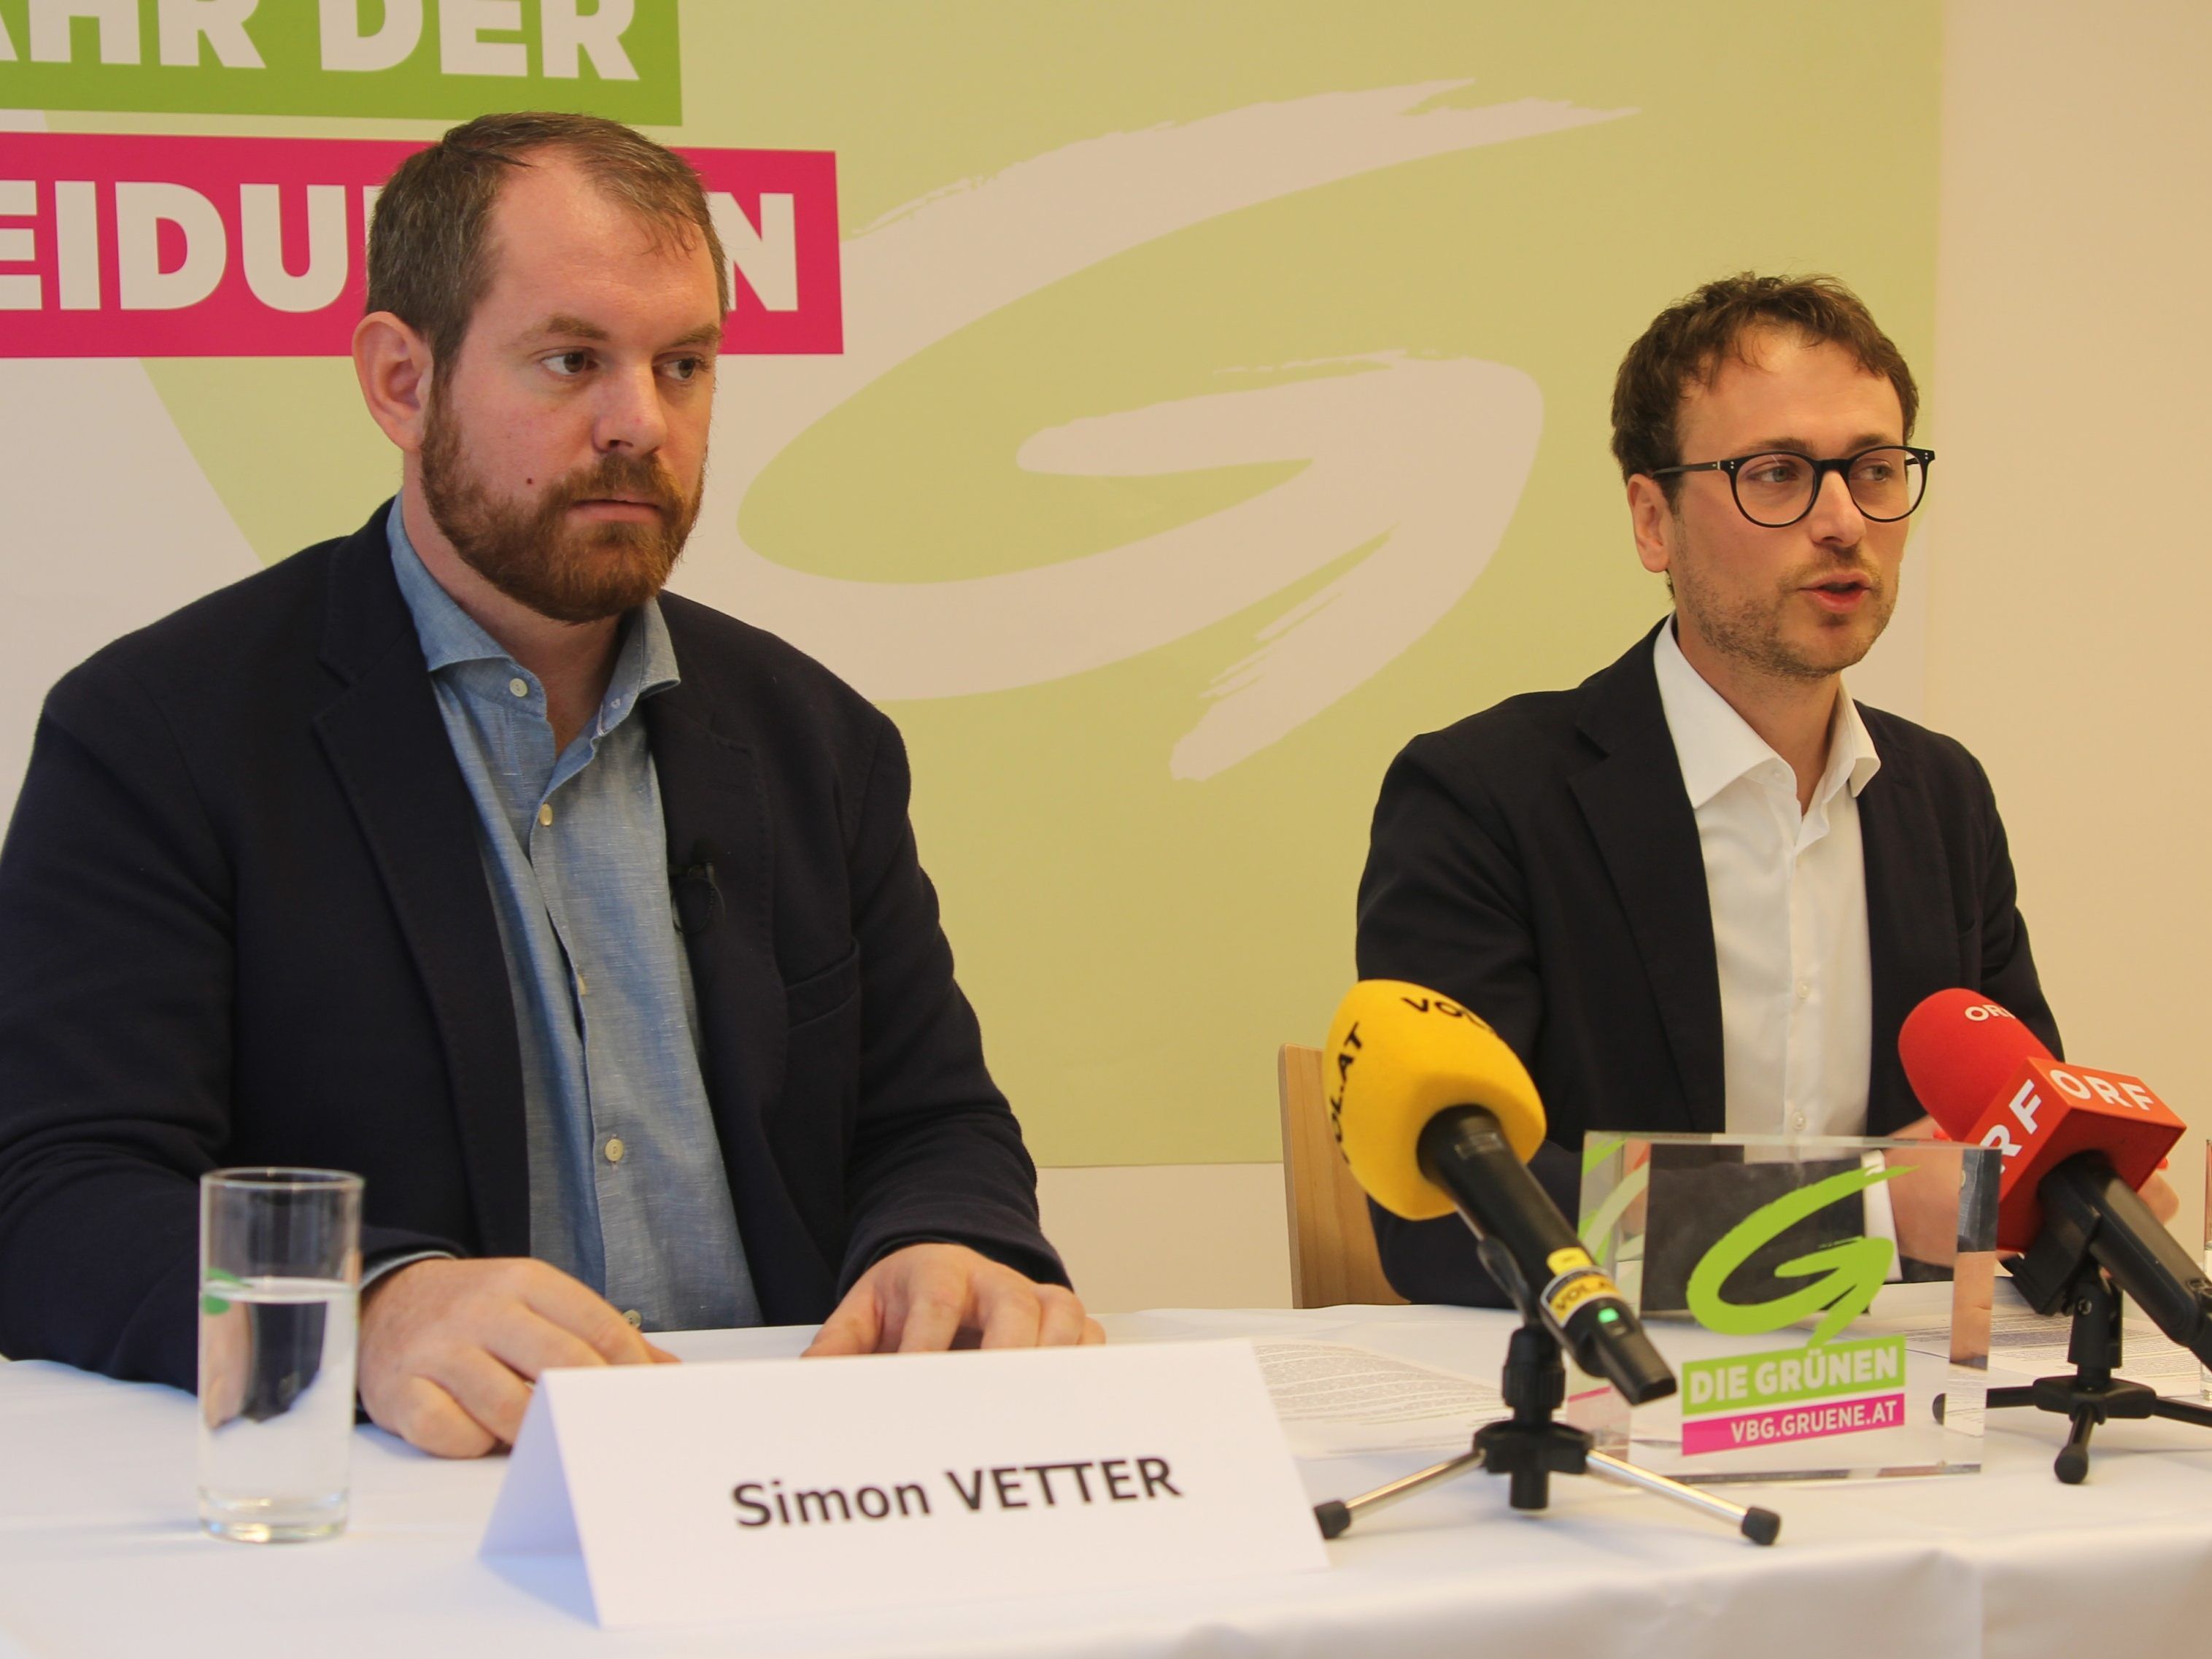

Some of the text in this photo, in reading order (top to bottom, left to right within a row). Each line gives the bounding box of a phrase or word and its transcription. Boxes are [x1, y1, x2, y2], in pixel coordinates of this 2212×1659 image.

[0, 0, 641, 81] HR DER
[1330, 1021, 1363, 1164] OL.AT
[1979, 1078, 2042, 1174] RF
[2049, 1069, 2154, 1111] ORF
[1690, 1345, 1897, 1405] DIE GRÜNEN
[1730, 1400, 1898, 1444] VBG.GRUENE.AT
[731, 1455, 1183, 1528] Simon VETTER
